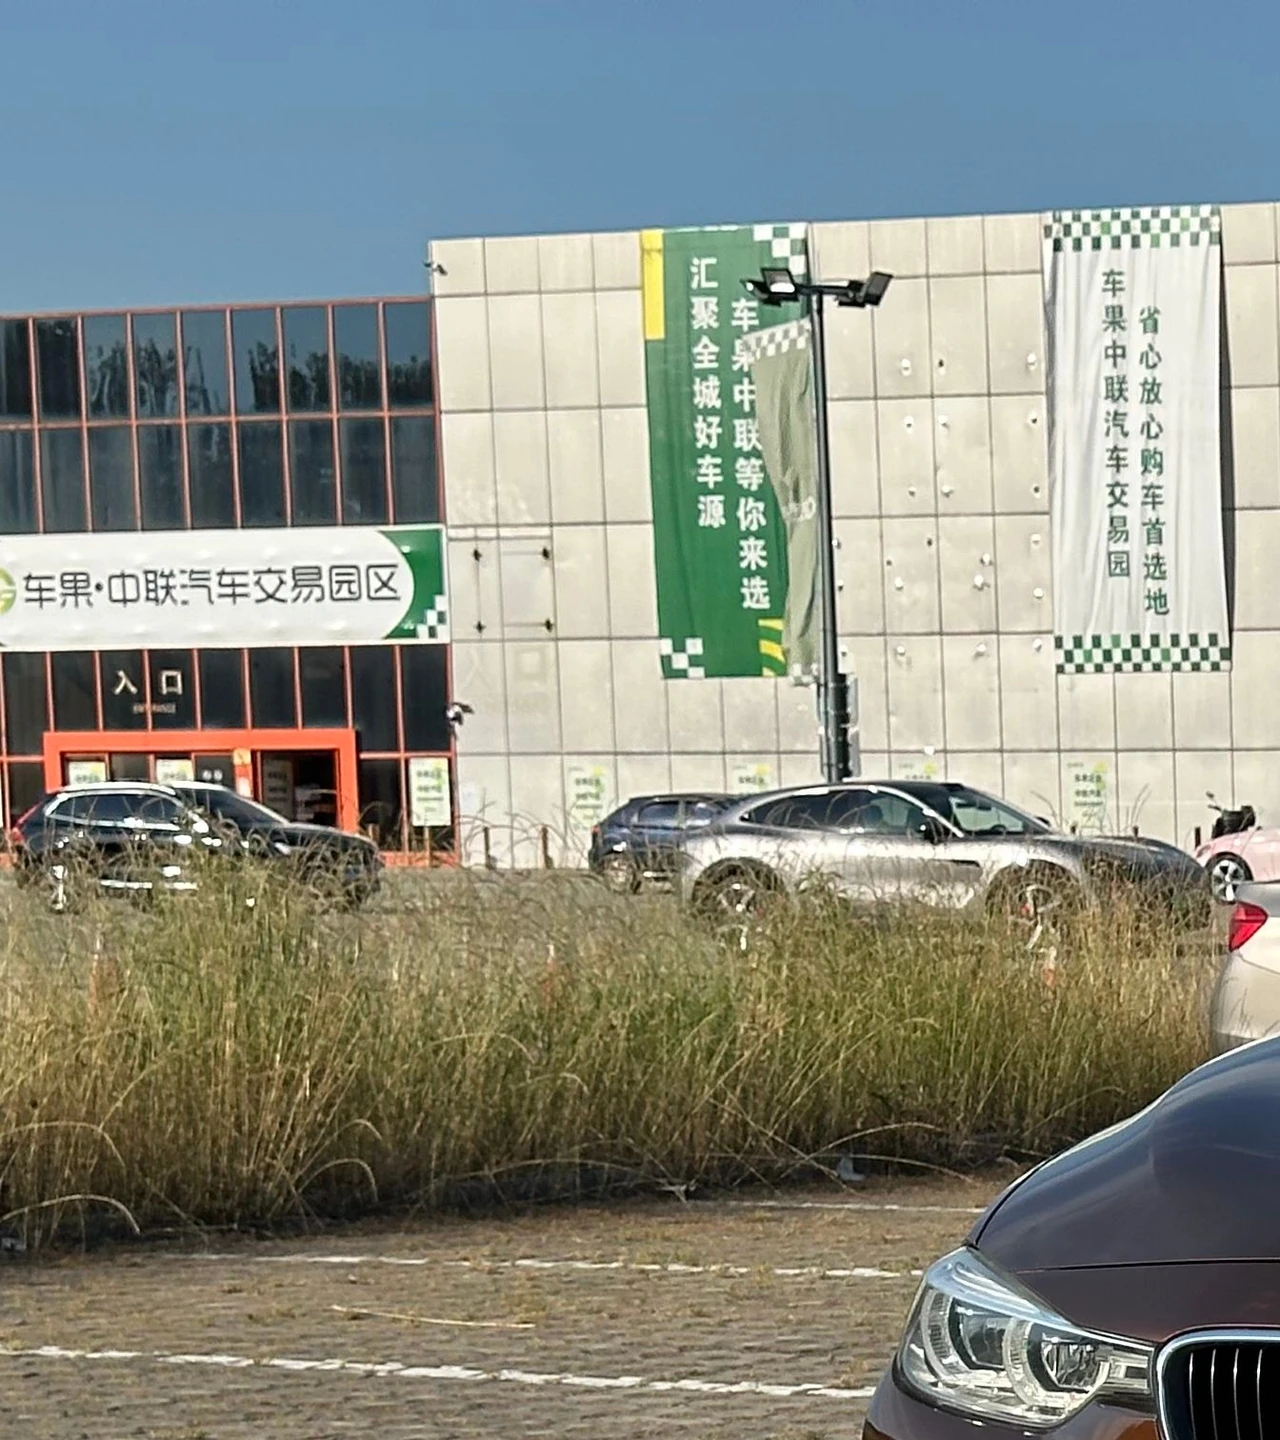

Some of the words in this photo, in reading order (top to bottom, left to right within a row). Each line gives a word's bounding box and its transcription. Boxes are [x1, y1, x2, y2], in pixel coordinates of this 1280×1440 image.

[690, 257, 726, 528] 汇聚全城好车源
[1102, 269, 1131, 577] 车果中联汽车交易园
[1139, 306, 1170, 616] 省心放心购车首选地
[23, 564, 400, 609] 车果·中联汽车交易园区
[114, 670, 183, 695] 入口
